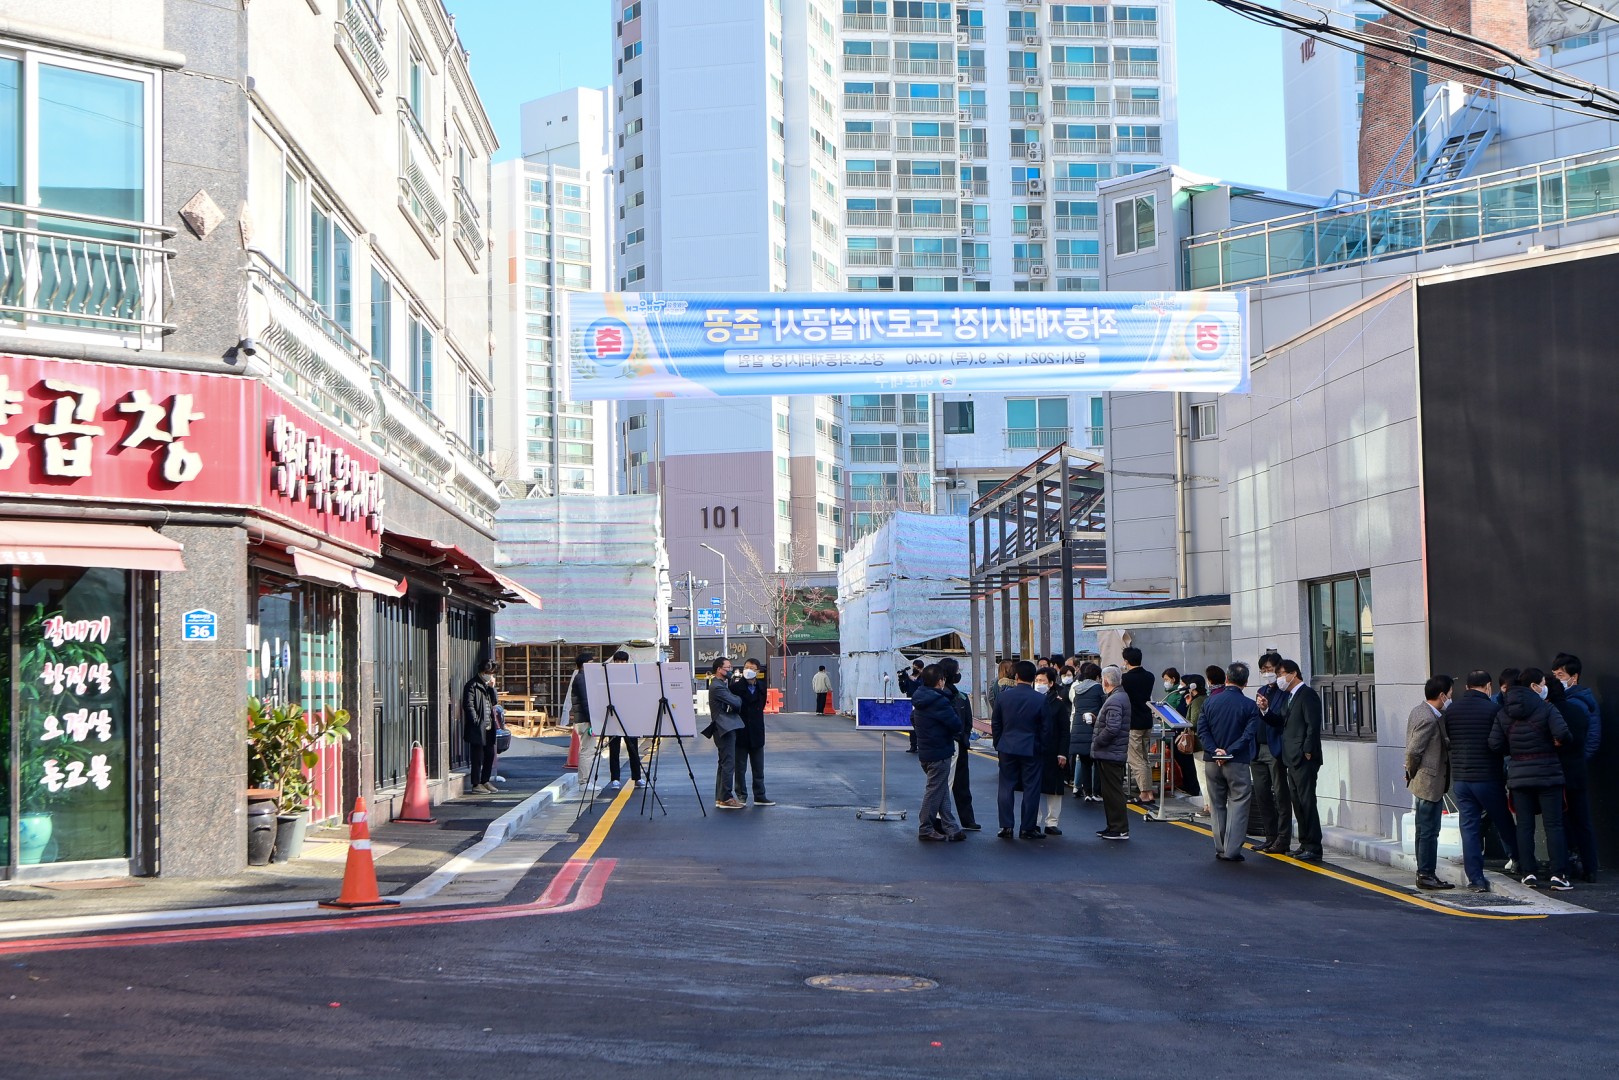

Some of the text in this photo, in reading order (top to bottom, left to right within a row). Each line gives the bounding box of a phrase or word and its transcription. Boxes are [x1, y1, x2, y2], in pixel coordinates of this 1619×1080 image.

[1300, 38, 1316, 64] 102
[700, 505, 740, 529] 101
[41, 615, 111, 647] 갈매기
[189, 625, 211, 638] 36
[40, 662, 112, 696] 항정살
[40, 708, 112, 742] 오겹살
